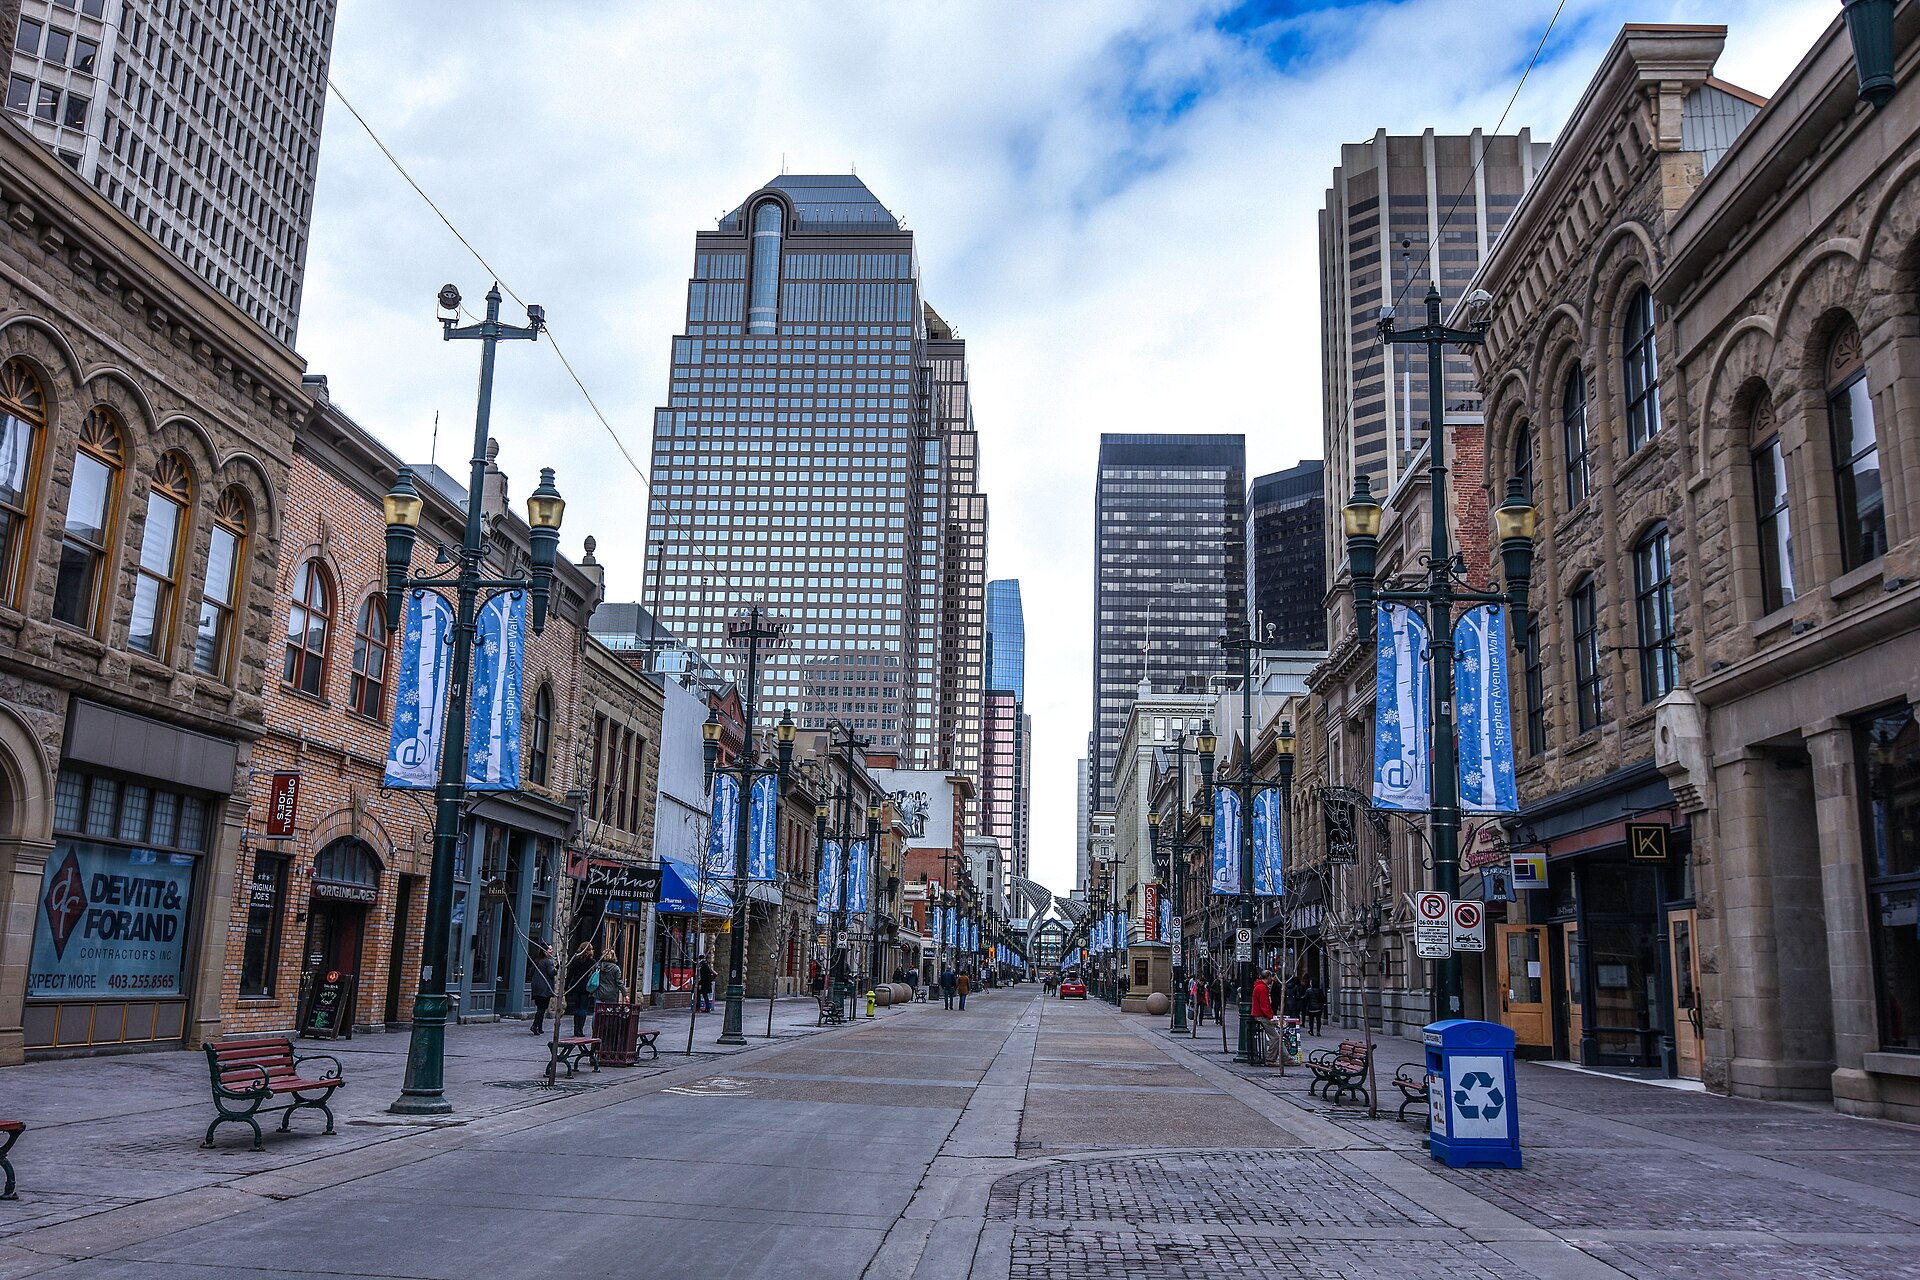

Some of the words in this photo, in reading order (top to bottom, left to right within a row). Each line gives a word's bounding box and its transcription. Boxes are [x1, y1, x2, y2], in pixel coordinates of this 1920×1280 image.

[508, 614, 518, 640] Walk
[1488, 630, 1498, 656] Walk
[506, 642, 516, 680] Avenue
[1490, 658, 1501, 697] Avenue
[504, 683, 516, 726] Stephen
[1492, 701, 1505, 746] Stephen
[282, 778, 296, 832] ORIGINAL
[320, 884, 356, 899] ORIGINAL
[488, 886, 507, 894] blink
[610, 889, 632, 898] CHEESE
[633, 890, 654, 899] BISTRO
[83, 908, 178, 942] FORAND
[80, 948, 156, 960] CONTRACTORS
[159, 950, 172, 960] INC
[68, 974, 96, 989] MORE
[108, 974, 174, 989] 403.255.8565
